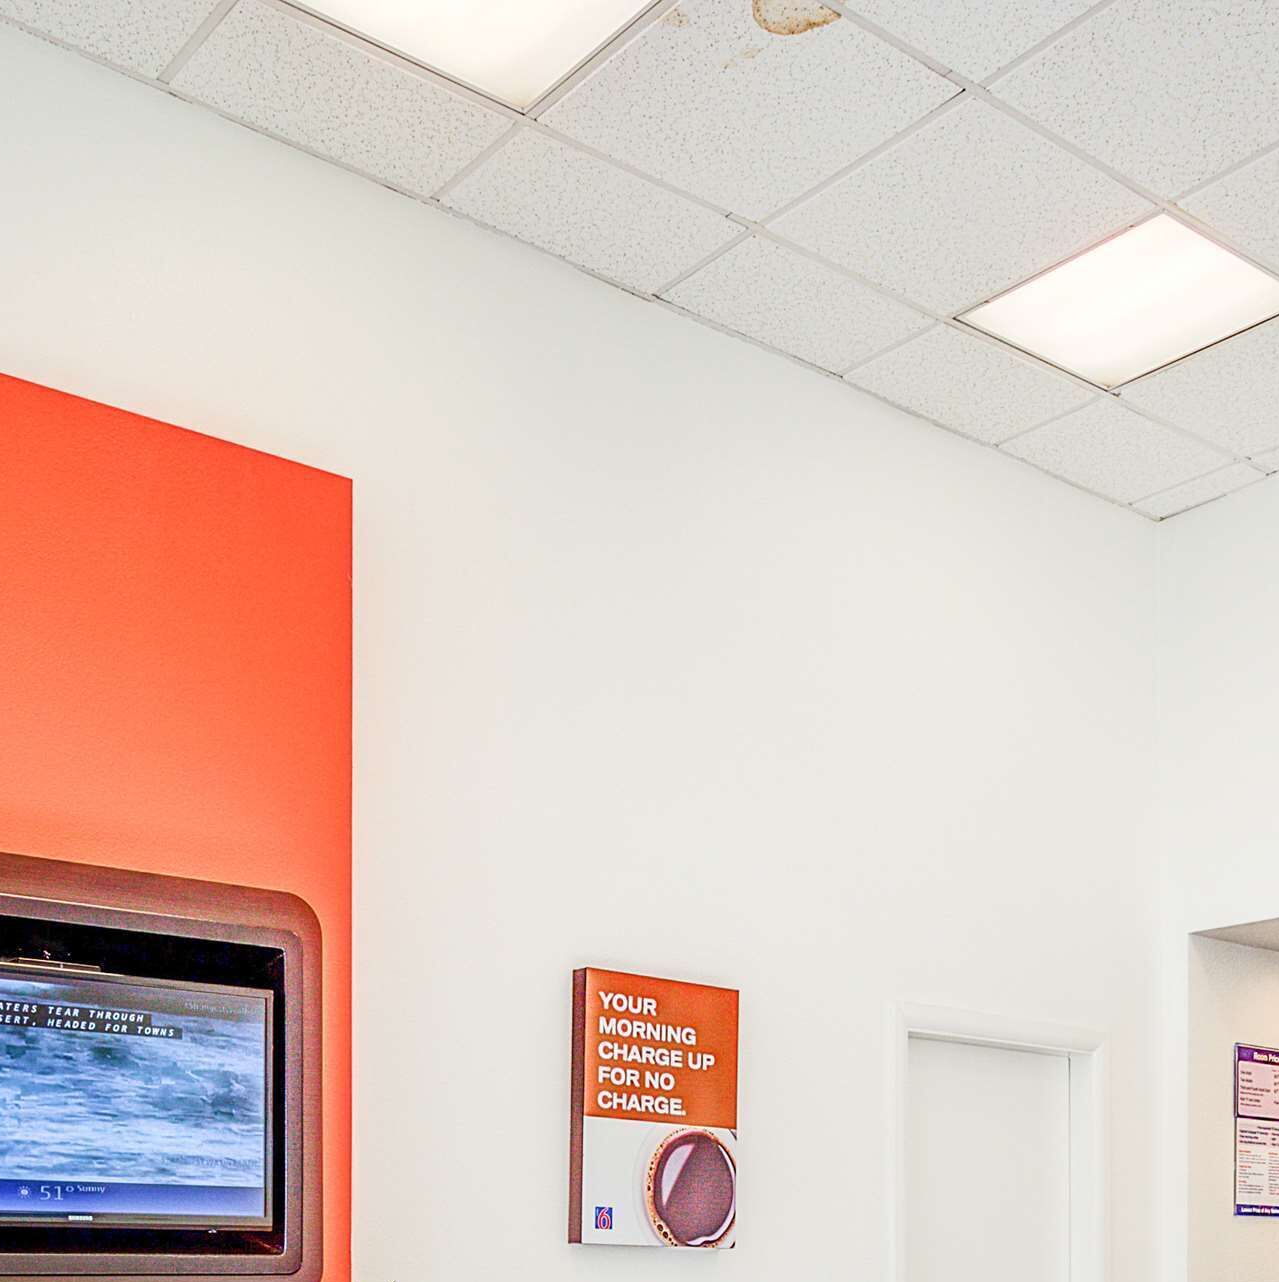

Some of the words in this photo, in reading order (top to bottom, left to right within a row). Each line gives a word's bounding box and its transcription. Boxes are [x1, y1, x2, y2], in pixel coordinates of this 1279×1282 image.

[47, 1006, 81, 1018] TEAR
[88, 1009, 145, 1023] THROUGH
[597, 991, 658, 1017] YOUR
[46, 1018, 97, 1031] HEADED
[104, 1022, 128, 1034] FOR
[136, 1025, 176, 1038] TOWNS
[597, 1016, 698, 1046] MORNING
[597, 1041, 684, 1068] CHARGE
[687, 1052, 716, 1072] UP
[597, 1065, 641, 1088] FOR
[644, 1070, 676, 1091] NO
[596, 1090, 687, 1117] CHARGE.
[76, 1184, 106, 1194] Sunny
[597, 1206, 611, 1230] 6
